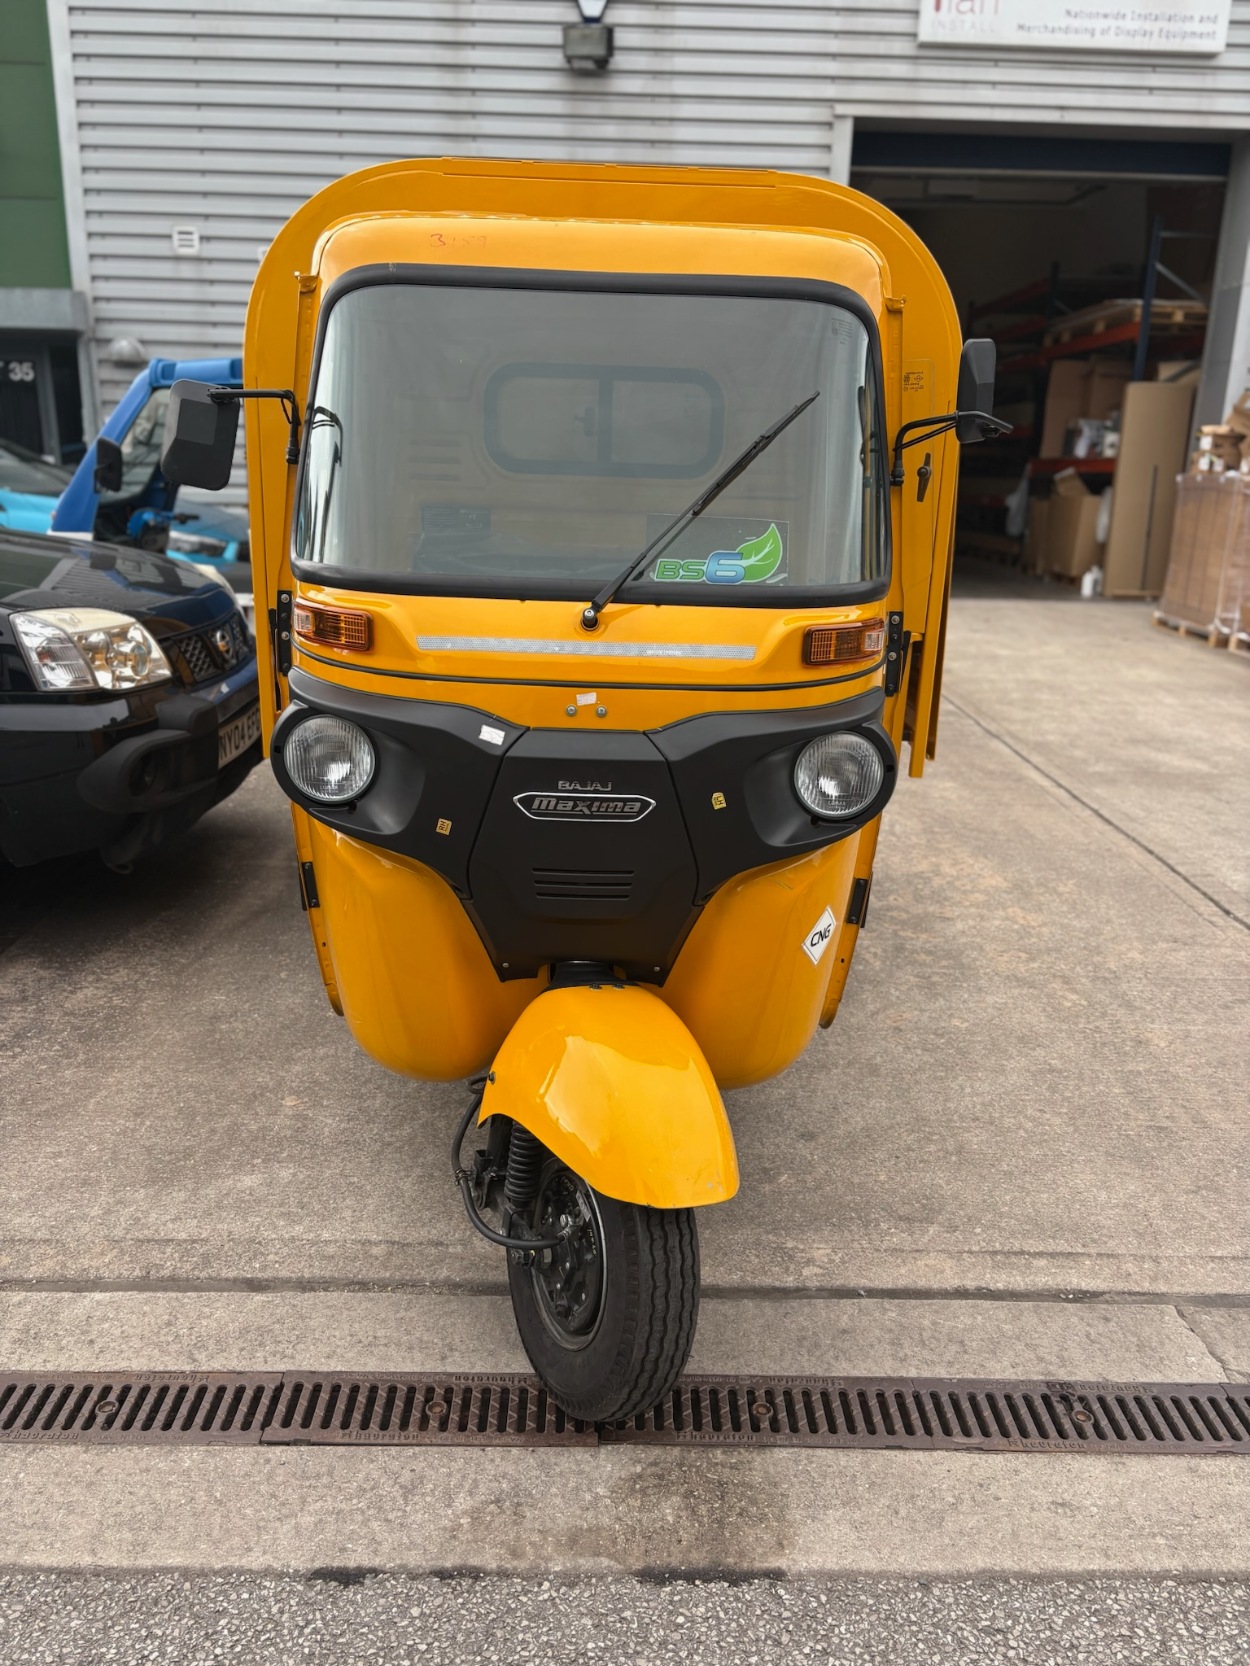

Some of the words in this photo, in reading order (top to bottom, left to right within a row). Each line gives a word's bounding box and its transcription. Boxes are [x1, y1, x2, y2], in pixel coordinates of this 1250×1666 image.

[932, 19, 996, 33] INSTALL
[1065, 9, 1127, 21] Nationwide
[1131, 10, 1195, 23] Installation
[1198, 13, 1219, 25] and
[1017, 23, 1096, 38] Merchandising
[1100, 27, 1111, 37] of
[1115, 26, 1154, 40] Display
[1158, 27, 1217, 42] Equipment
[8, 360, 35, 382] 35
[655, 551, 746, 584] BS6
[220, 719, 246, 761] NY04
[557, 780, 613, 792] BAJAJ
[810, 923, 832, 948] CNG
